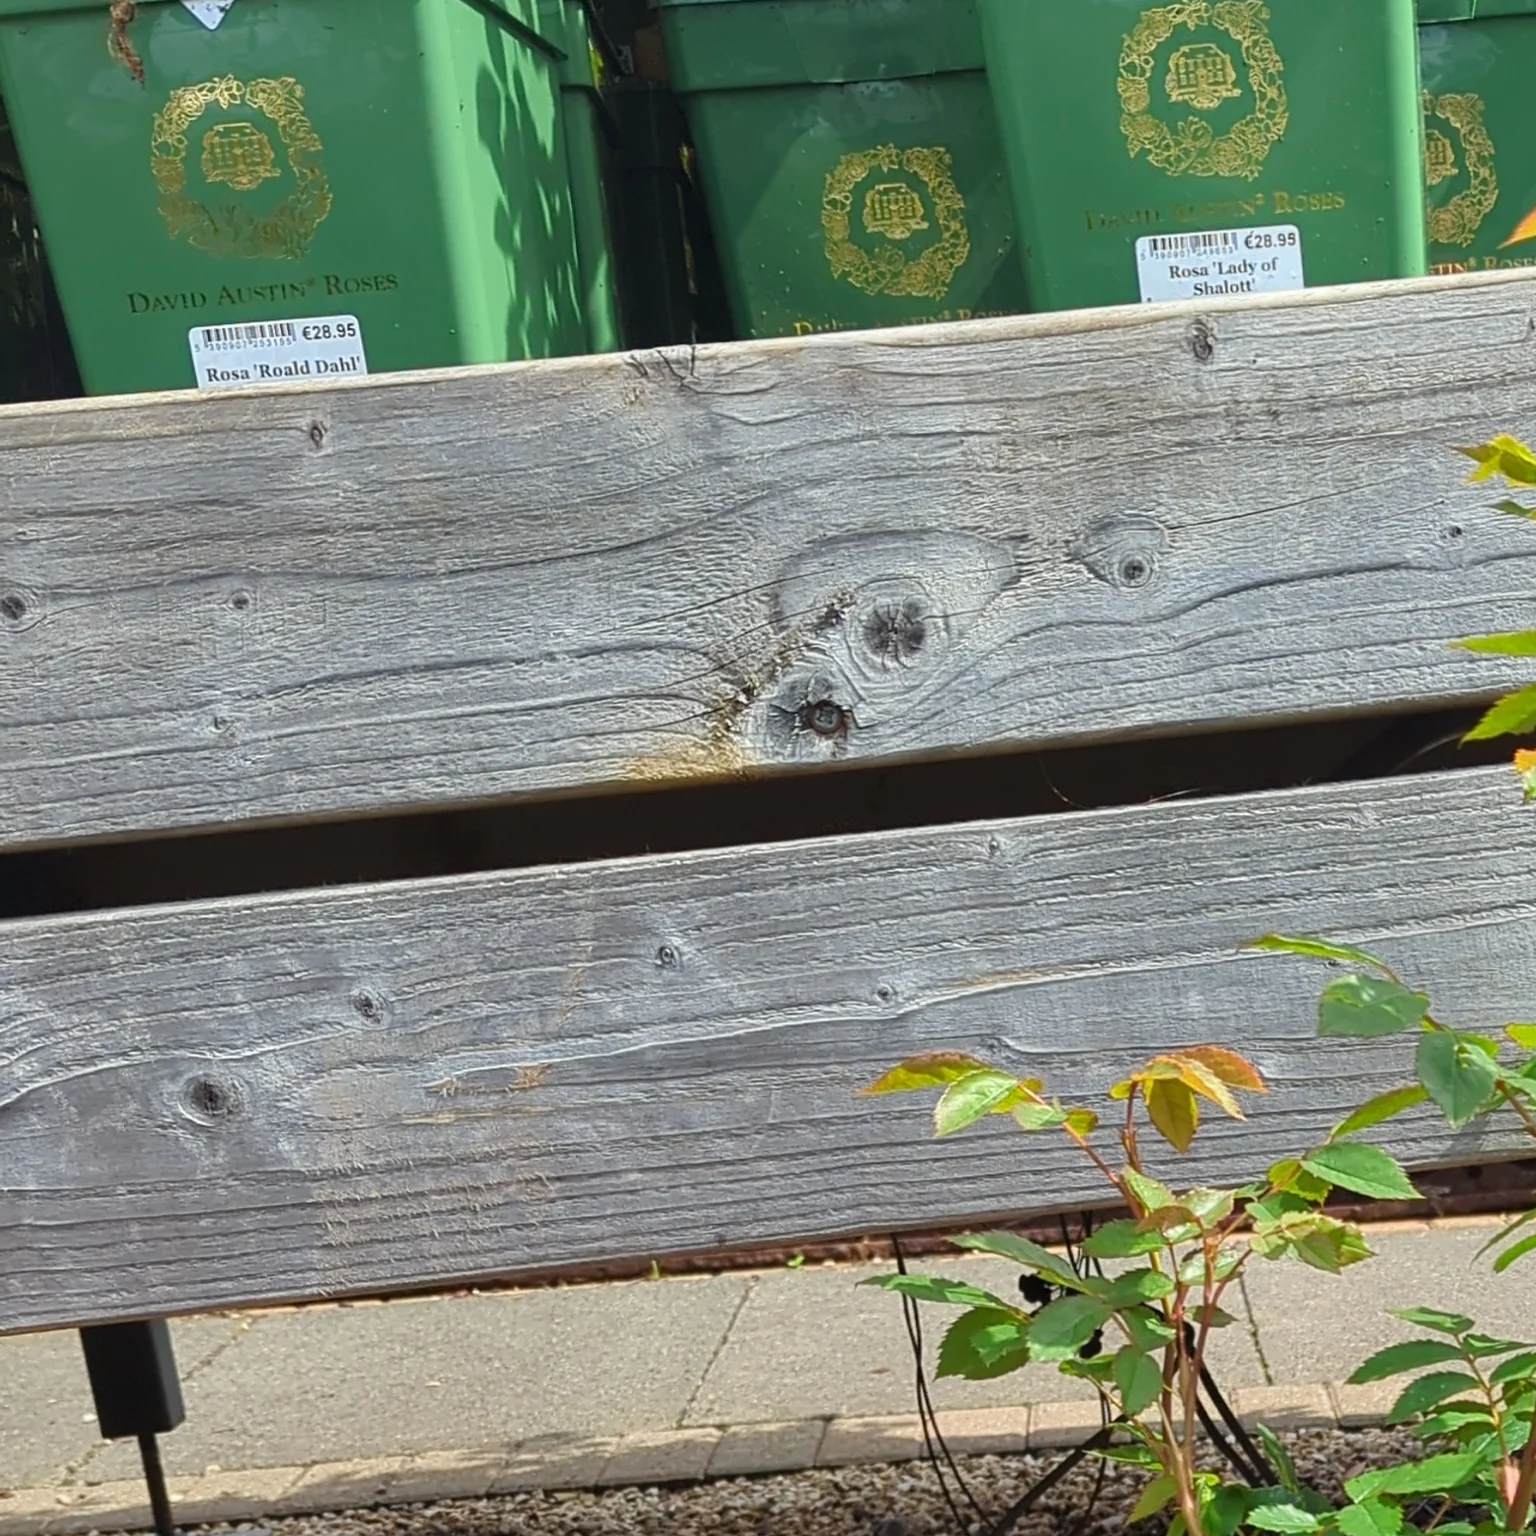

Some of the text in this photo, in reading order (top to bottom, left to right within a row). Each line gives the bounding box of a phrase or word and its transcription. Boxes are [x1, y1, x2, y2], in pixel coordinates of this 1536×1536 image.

[1274, 191, 1345, 214] ROSES
[1245, 232, 1296, 250] €28.95
[1169, 257, 1278, 279] Rosa 'Lady of
[127, 291, 207, 313] DAVID
[322, 274, 399, 295] ROSES
[1193, 278, 1256, 296] Shalott'
[302, 322, 356, 341] €28.95
[206, 356, 361, 382] Rosa 'Roald Dahl'
